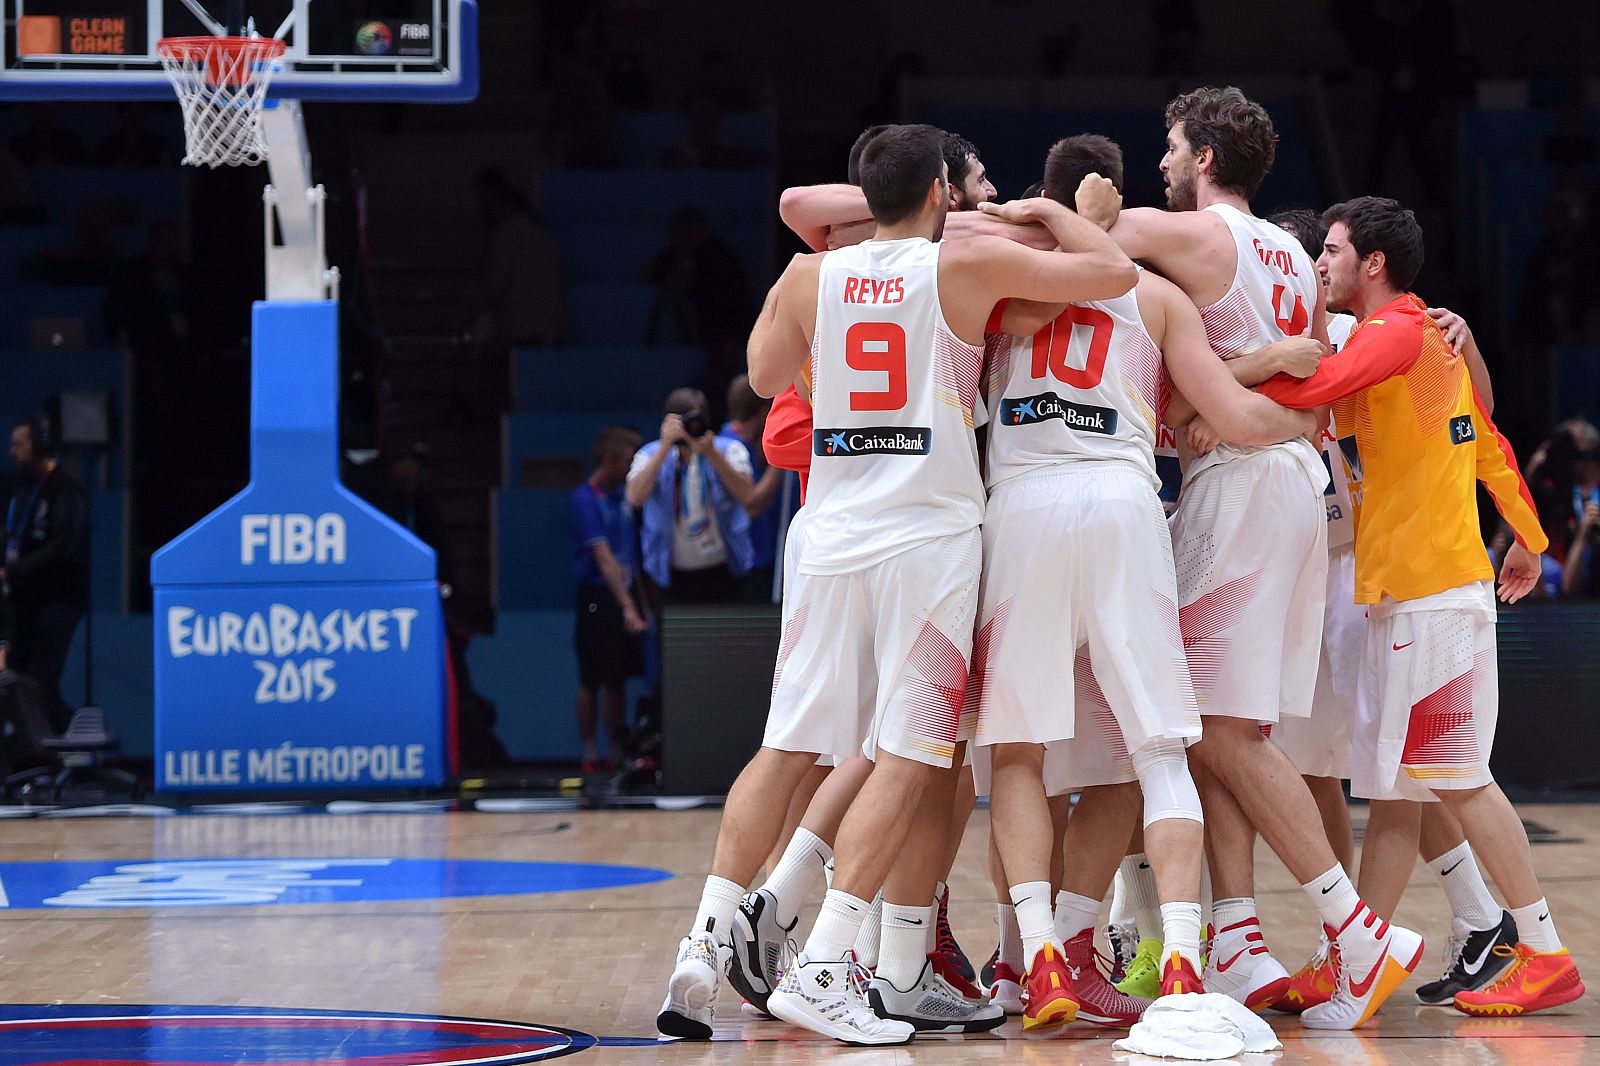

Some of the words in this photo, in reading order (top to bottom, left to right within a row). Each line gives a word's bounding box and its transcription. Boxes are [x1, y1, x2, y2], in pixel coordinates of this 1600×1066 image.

[70, 18, 124, 34] CLEAN
[400, 24, 430, 39] FIBA
[70, 36, 124, 53] GAME
[843, 276, 905, 304] REYES
[1031, 304, 1115, 390] 10
[846, 322, 908, 412] 9
[849, 432, 924, 451] CaixaBank
[240, 512, 346, 565] FIBA
[252, 658, 337, 704] 2015
[164, 750, 241, 785] LILLE
[247, 741, 425, 783] MÉTROPOLE
